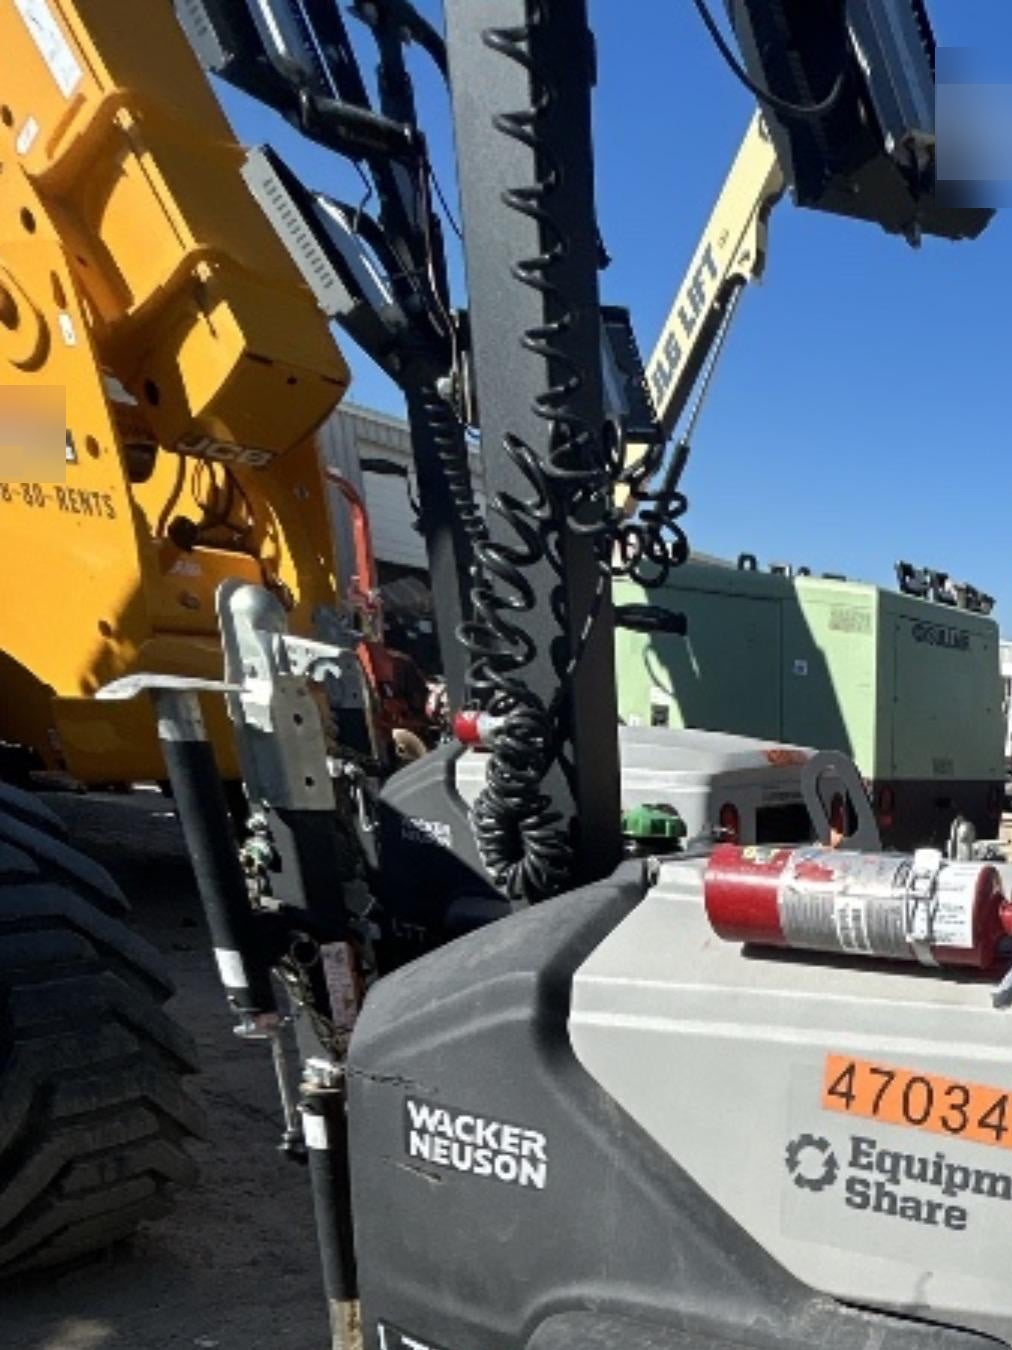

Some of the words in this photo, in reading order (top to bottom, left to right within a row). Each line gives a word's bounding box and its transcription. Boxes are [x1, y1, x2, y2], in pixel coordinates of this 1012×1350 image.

[176, 438, 273, 466] JCB
[406, 1099, 549, 1162] WACKER
[408, 1129, 548, 1190] NEUSON
[844, 1174, 968, 1231] Share
